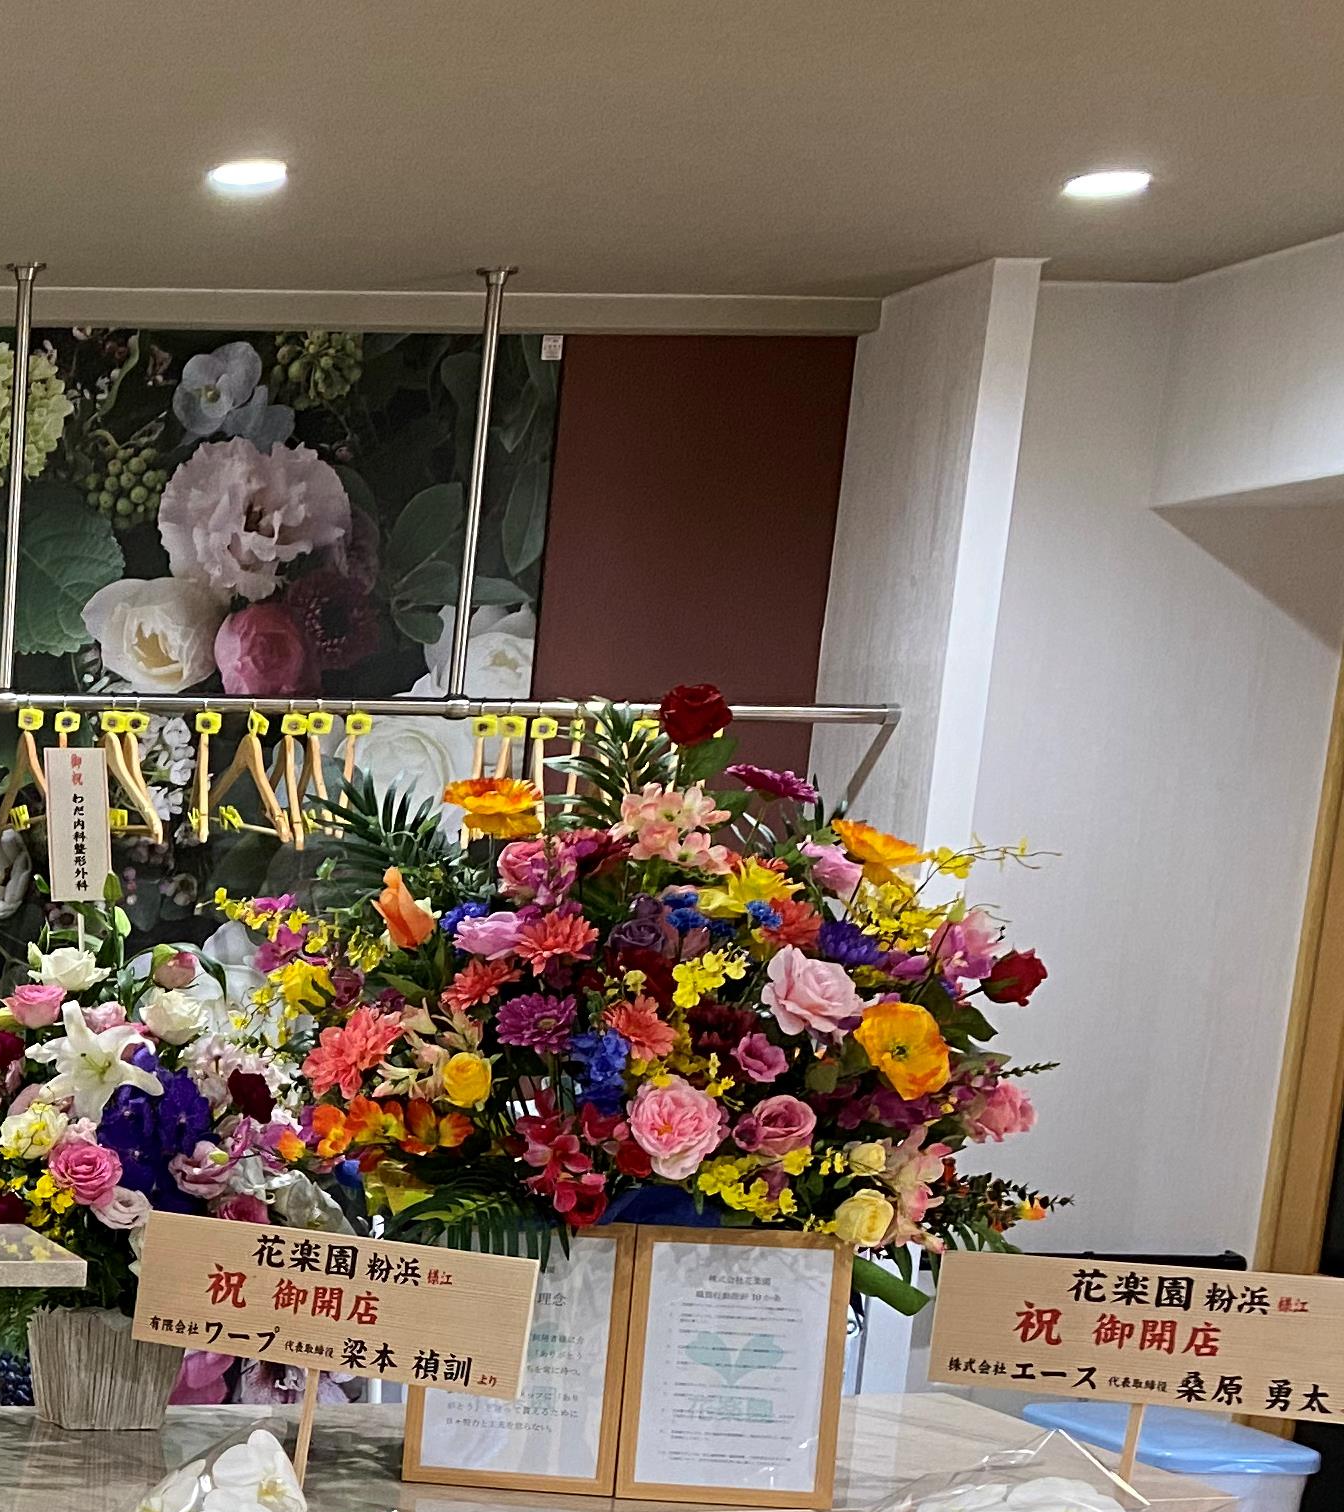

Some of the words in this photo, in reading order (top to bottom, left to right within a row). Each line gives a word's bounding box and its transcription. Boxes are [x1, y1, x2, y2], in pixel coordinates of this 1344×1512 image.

[72, 793, 89, 892] わだ内科整形外科
[251, 1233, 359, 1280] 花楽園
[366, 1252, 422, 1287] 粉浜
[205, 1263, 247, 1310] 祝
[271, 1277, 381, 1326] 御開店
[1066, 1268, 1195, 1312] 花楽園
[1204, 1282, 1271, 1316] 粉浜
[149, 1314, 200, 1336] 有限会社
[204, 1320, 281, 1354] ワープ
[284, 1340, 334, 1359] 代表取締役
[476, 1373, 497, 1388] より
[1012, 1299, 1063, 1347] 祝
[1092, 1312, 1223, 1358] 御開店
[947, 1355, 1007, 1376] 株式会社
[1010, 1362, 1097, 1391] エース
[1108, 1376, 1168, 1393] 代表取締役
[1176, 1370, 1244, 1407] 桑原
[1264, 1378, 1333, 1415] 勇太
